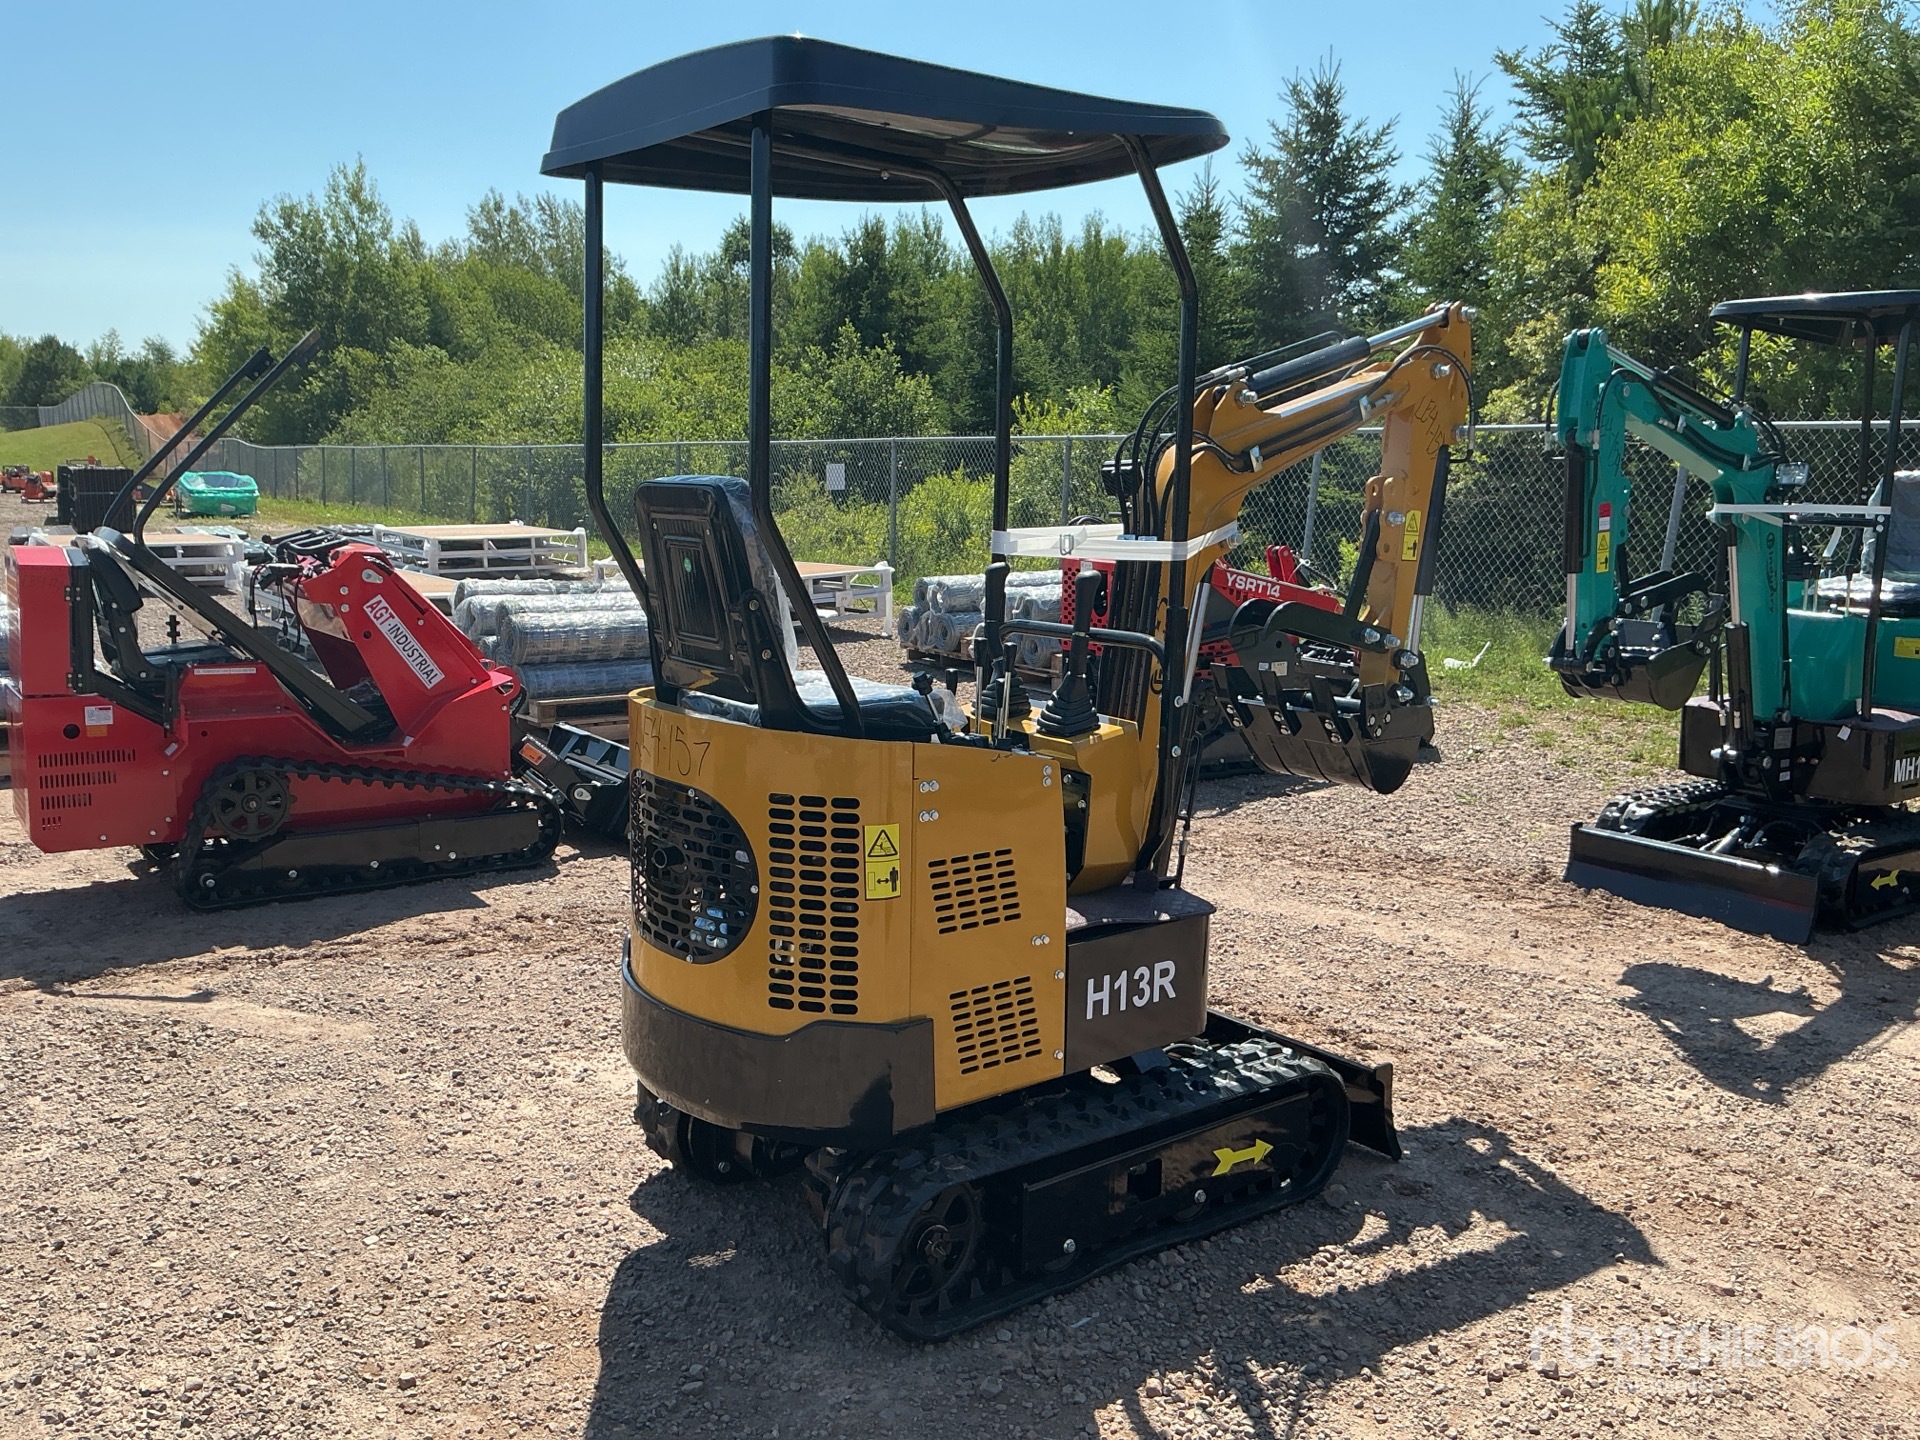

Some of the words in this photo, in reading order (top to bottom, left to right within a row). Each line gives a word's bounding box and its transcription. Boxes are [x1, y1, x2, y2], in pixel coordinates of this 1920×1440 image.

[1226, 572, 1280, 597] YSRT14
[366, 599, 395, 626] AGT
[387, 623, 439, 685] INDUSTRIAL
[1086, 960, 1176, 1020] H13R
